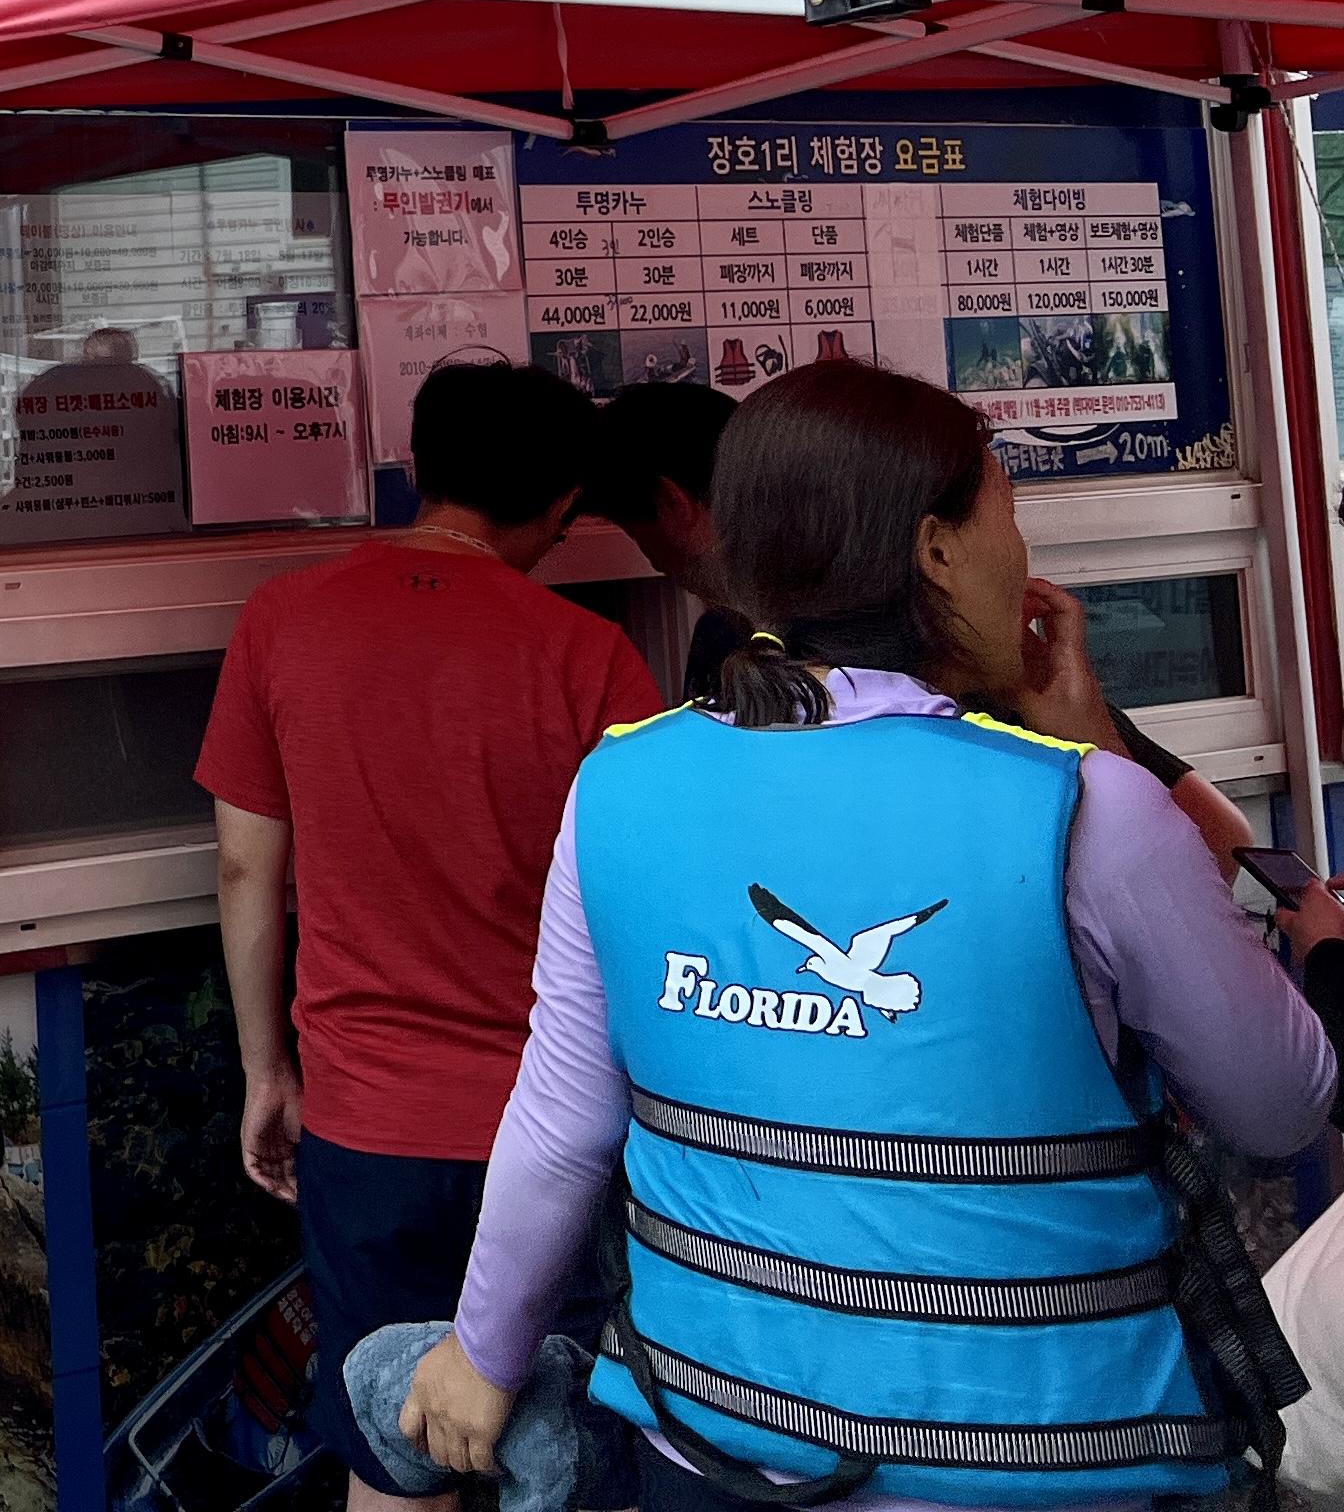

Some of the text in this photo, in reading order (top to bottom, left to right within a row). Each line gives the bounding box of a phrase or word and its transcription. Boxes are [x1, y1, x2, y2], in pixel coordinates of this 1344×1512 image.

[708, 136, 966, 175] 장호1리 체험장 요금표
[576, 191, 647, 215] 투명카누
[748, 190, 812, 213] 스노클링
[1013, 188, 1085, 210] 체험다이빙
[549, 228, 588, 250] 4인승
[638, 227, 676, 248] 2인승
[731, 227, 759, 246] 세트
[812, 225, 838, 245] 단품
[1023, 223, 1079, 242] 체험+영상
[643, 265, 675, 285] 30분
[967, 258, 999, 277] 1시간
[1039, 257, 1070, 276] 1시간
[1101, 255, 1154, 275] 1시간 30분
[555, 267, 588, 287] 30분
[804, 297, 854, 318] 6,000원
[957, 292, 1012, 313] 80,000원
[1027, 291, 1087, 311] 120,000원
[1101, 289, 1159, 308] 150,000원
[541, 304, 606, 327] 44,000원
[630, 301, 692, 324] 22,000원
[721, 299, 780, 320] 11,000원
[214, 386, 339, 411] 체험장 이용시간
[212, 423, 268, 445] 아침:9시
[293, 420, 346, 441] 오후7시
